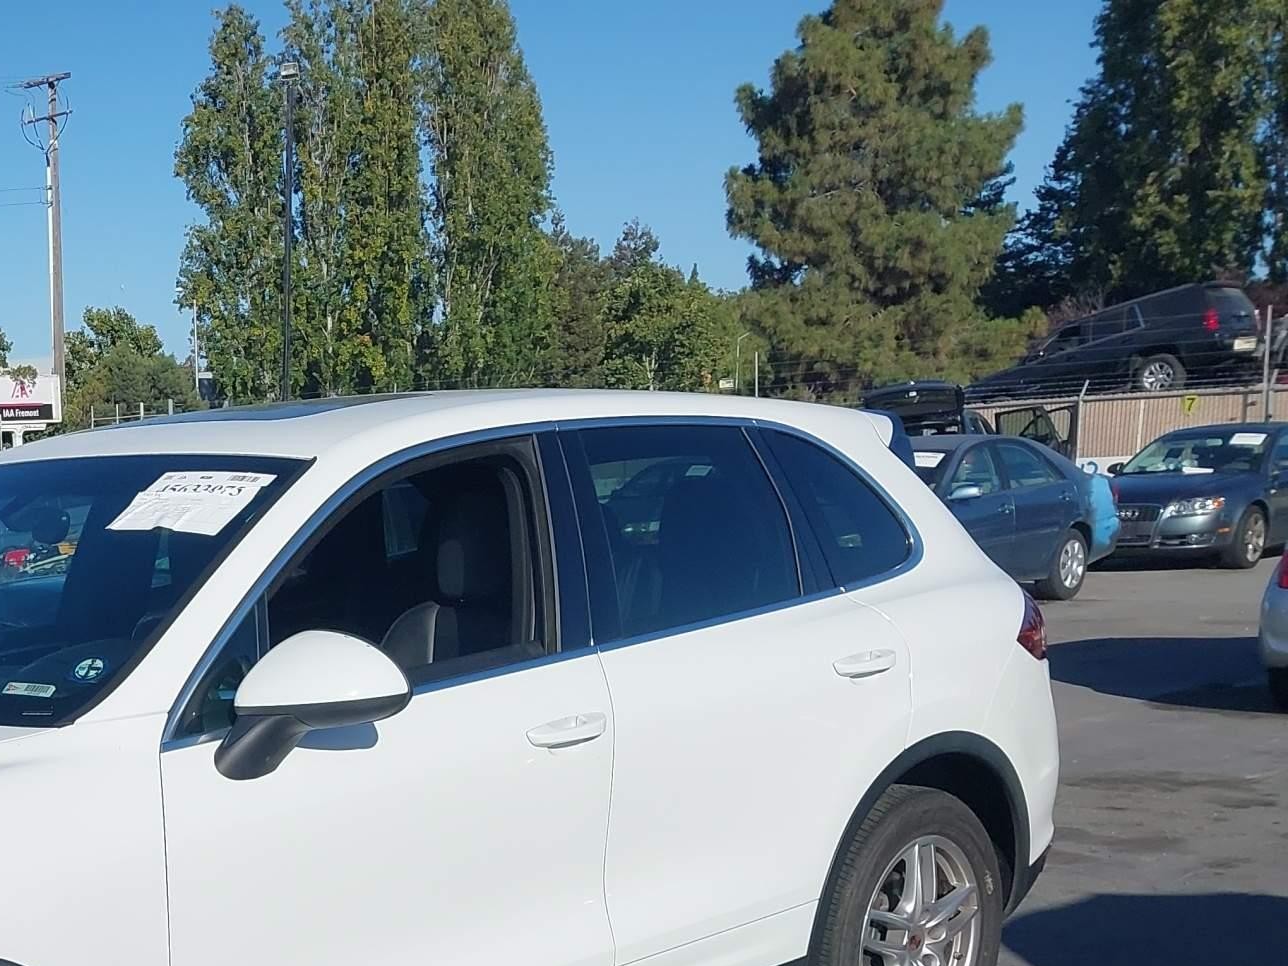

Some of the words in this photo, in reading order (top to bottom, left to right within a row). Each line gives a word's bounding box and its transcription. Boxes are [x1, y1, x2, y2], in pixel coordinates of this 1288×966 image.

[1186, 397, 1197, 412] 7
[2, 408, 14, 418] IAA
[15, 408, 40, 418] Fremont
